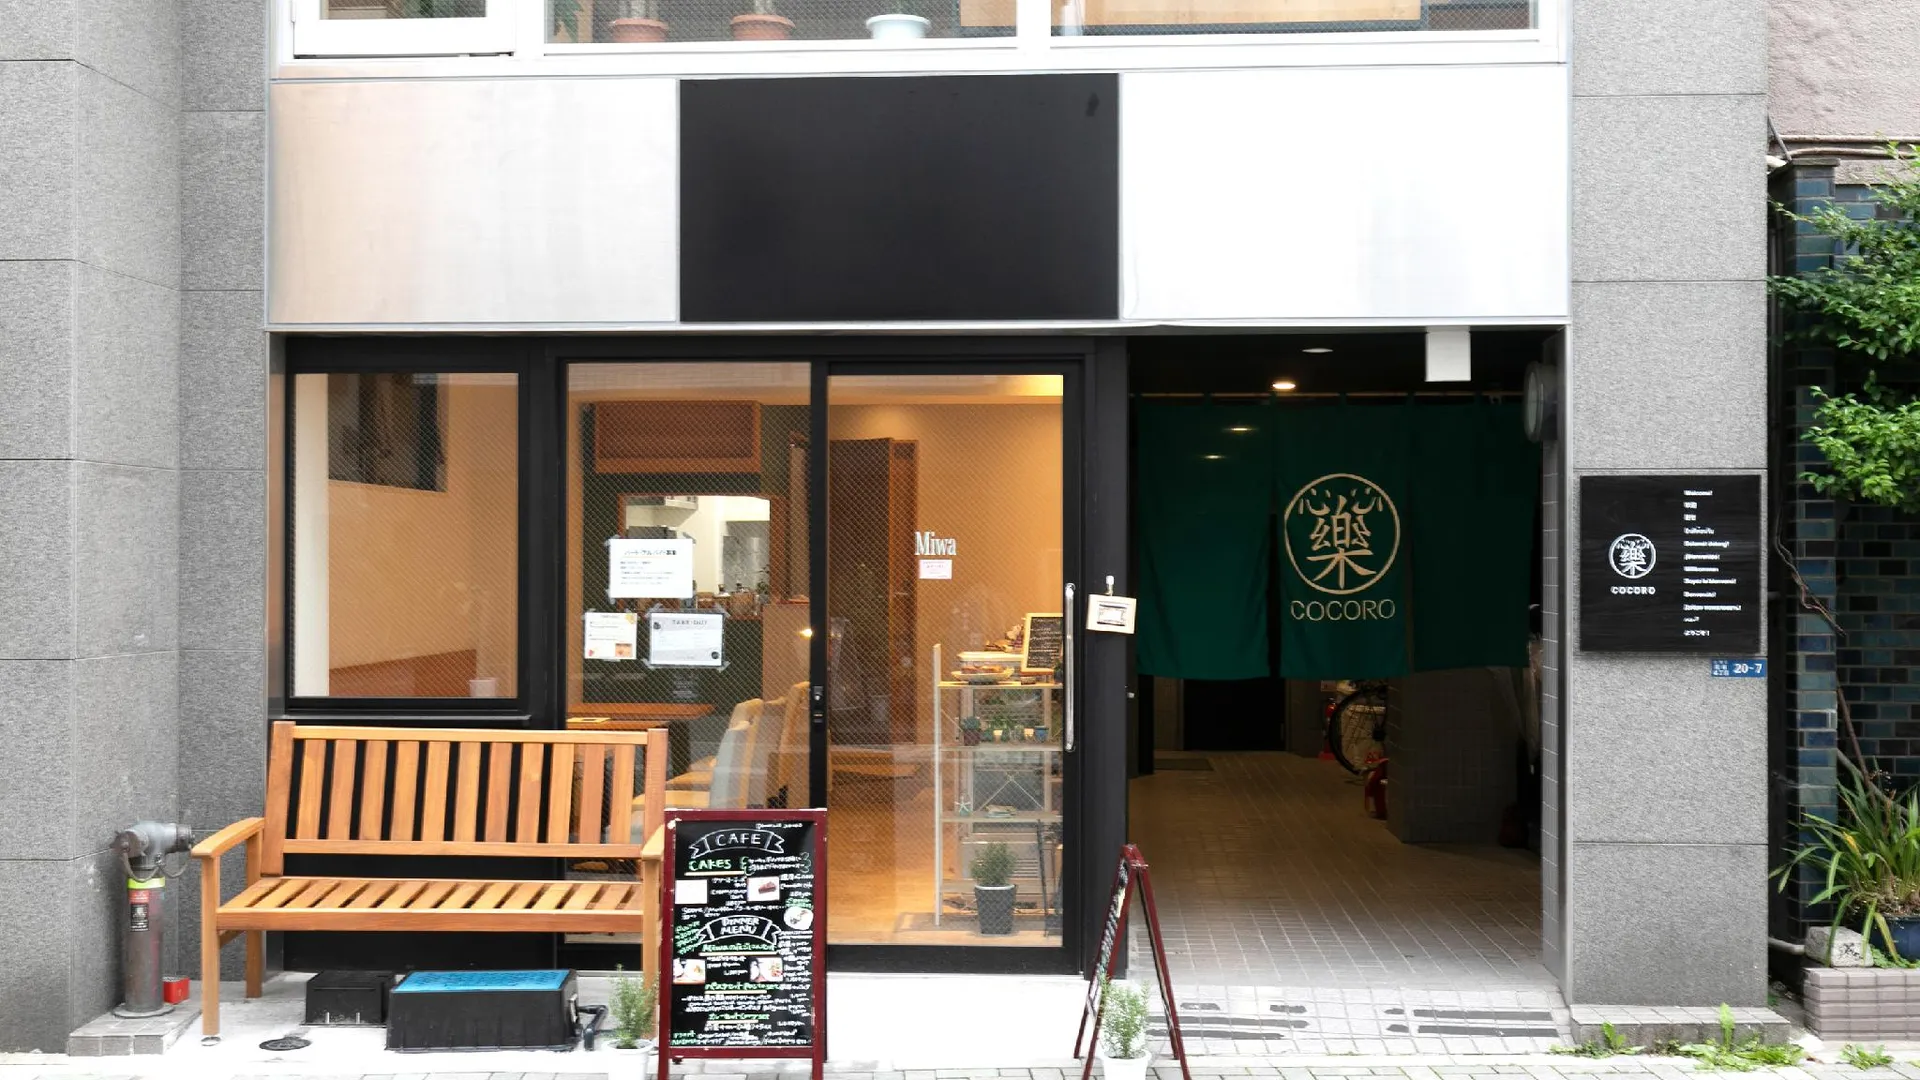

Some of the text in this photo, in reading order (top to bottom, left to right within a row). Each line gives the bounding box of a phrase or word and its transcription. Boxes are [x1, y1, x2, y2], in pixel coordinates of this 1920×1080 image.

[914, 531, 957, 556] Miwa
[1610, 586, 1656, 595] COCORO
[1290, 598, 1396, 621] COCORO
[715, 832, 761, 847] CAFE
[688, 858, 732, 871] CAKES
[721, 917, 760, 926] DINNER
[720, 925, 757, 935] MENU
